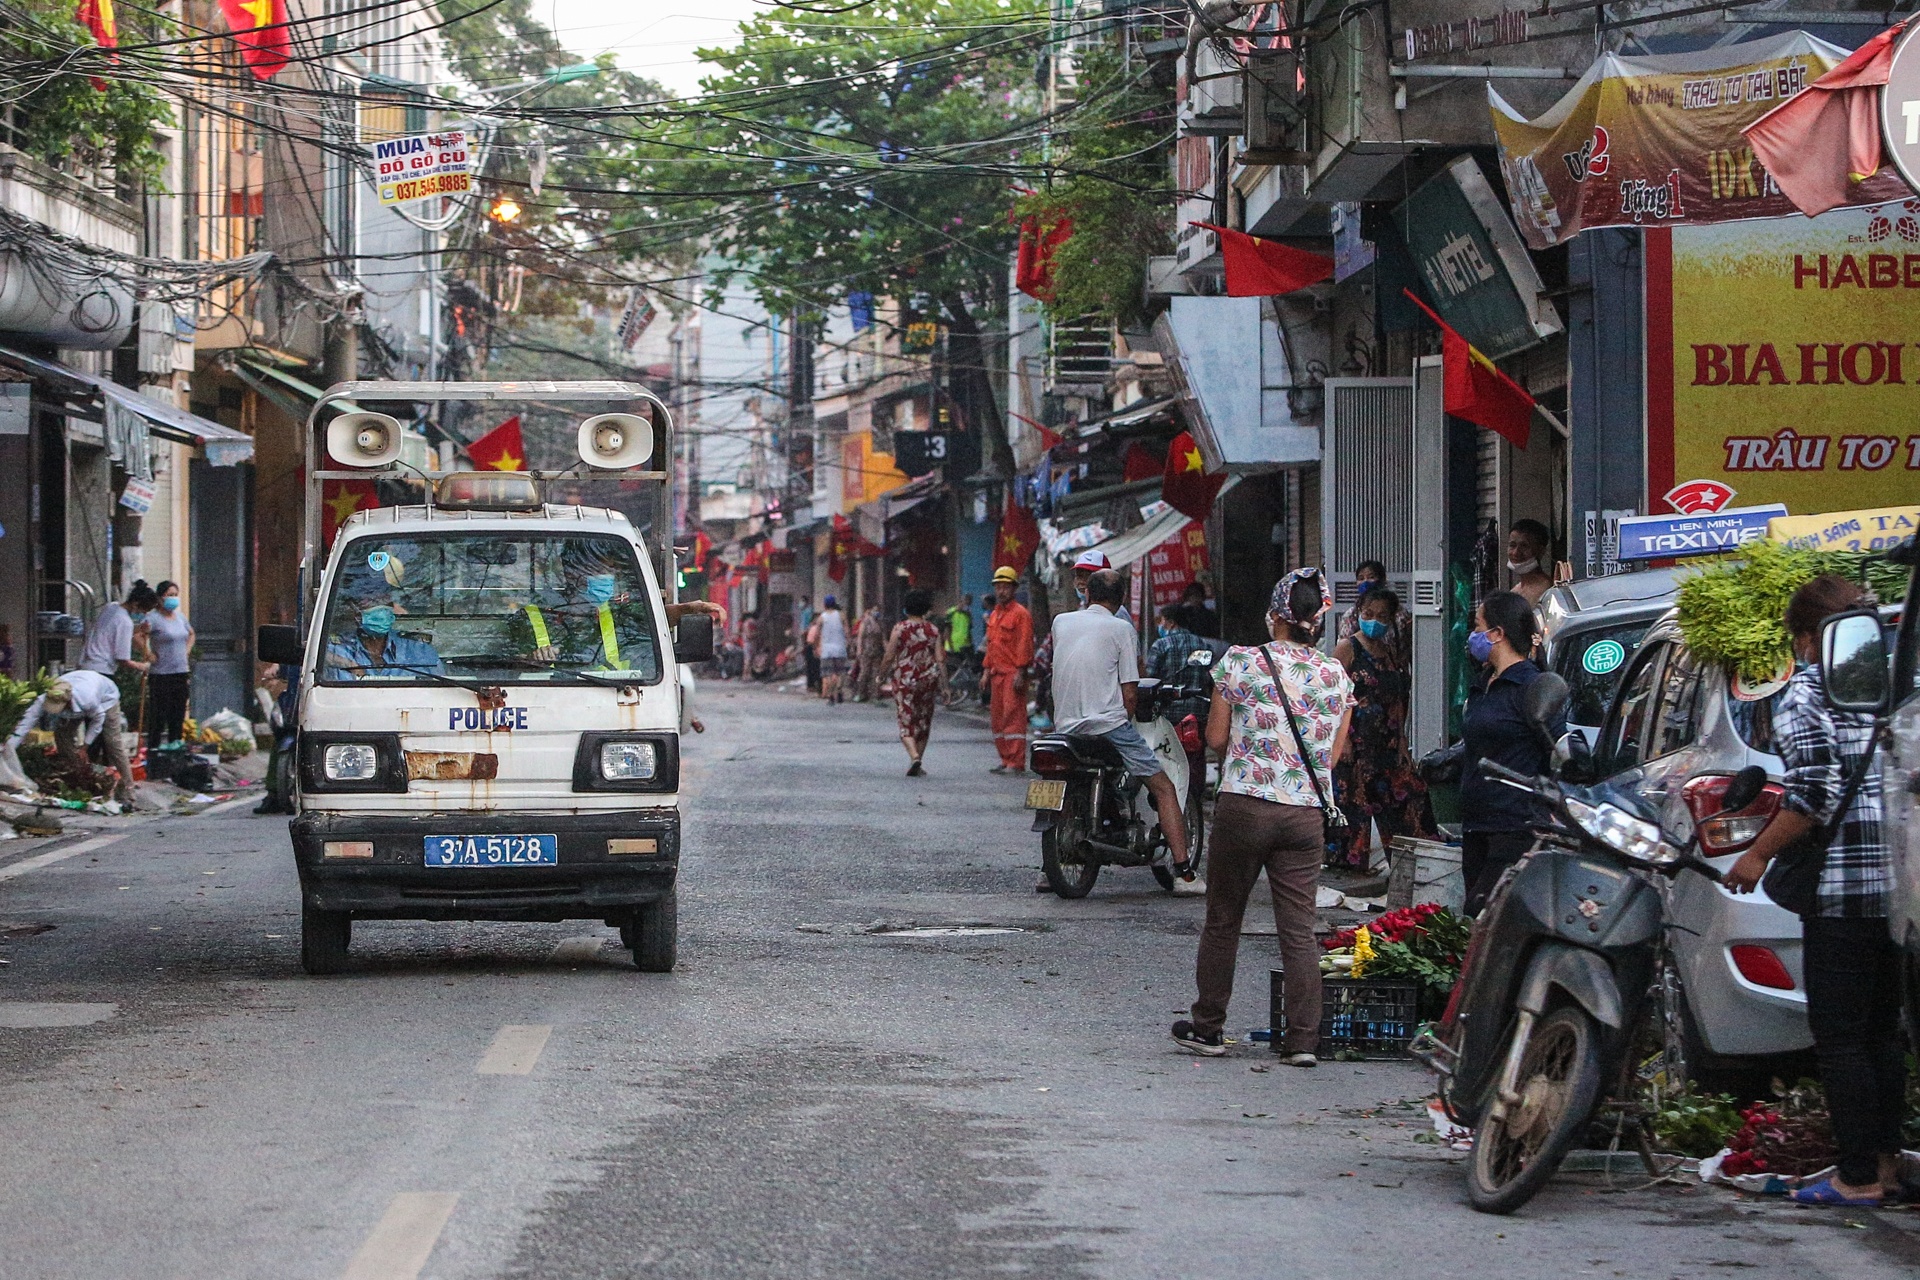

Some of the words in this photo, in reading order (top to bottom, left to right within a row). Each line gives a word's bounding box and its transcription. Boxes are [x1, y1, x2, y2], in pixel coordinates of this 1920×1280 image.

[1646, 83, 1675, 109] hàng
[1682, 75, 1722, 109] TRÂU
[1746, 67, 1773, 102] TÂY
[376, 138, 425, 159] MUA
[1587, 124, 1610, 177] 2
[379, 156, 404, 175] ĐỒ
[411, 151, 433, 169] GỖ
[438, 149, 465, 164] CŨ
[396, 174, 468, 200] 037.545.9885
[1620, 178, 1668, 222] Tặng
[1667, 168, 1685, 218] 1
[1847, 235, 1865, 243] Est.
[1691, 342, 1791, 386] BIA
[1796, 341, 1906, 386] HƠI
[1723, 427, 1831, 471] TRÂU
[1838, 435, 1900, 471] TƠ
[1587, 518, 1608, 537] SA
[1670, 522, 1702, 532] LIEN
[1707, 519, 1743, 530] MINH
[1870, 512, 1920, 531] TA
[449, 707, 528, 730] POLICE
